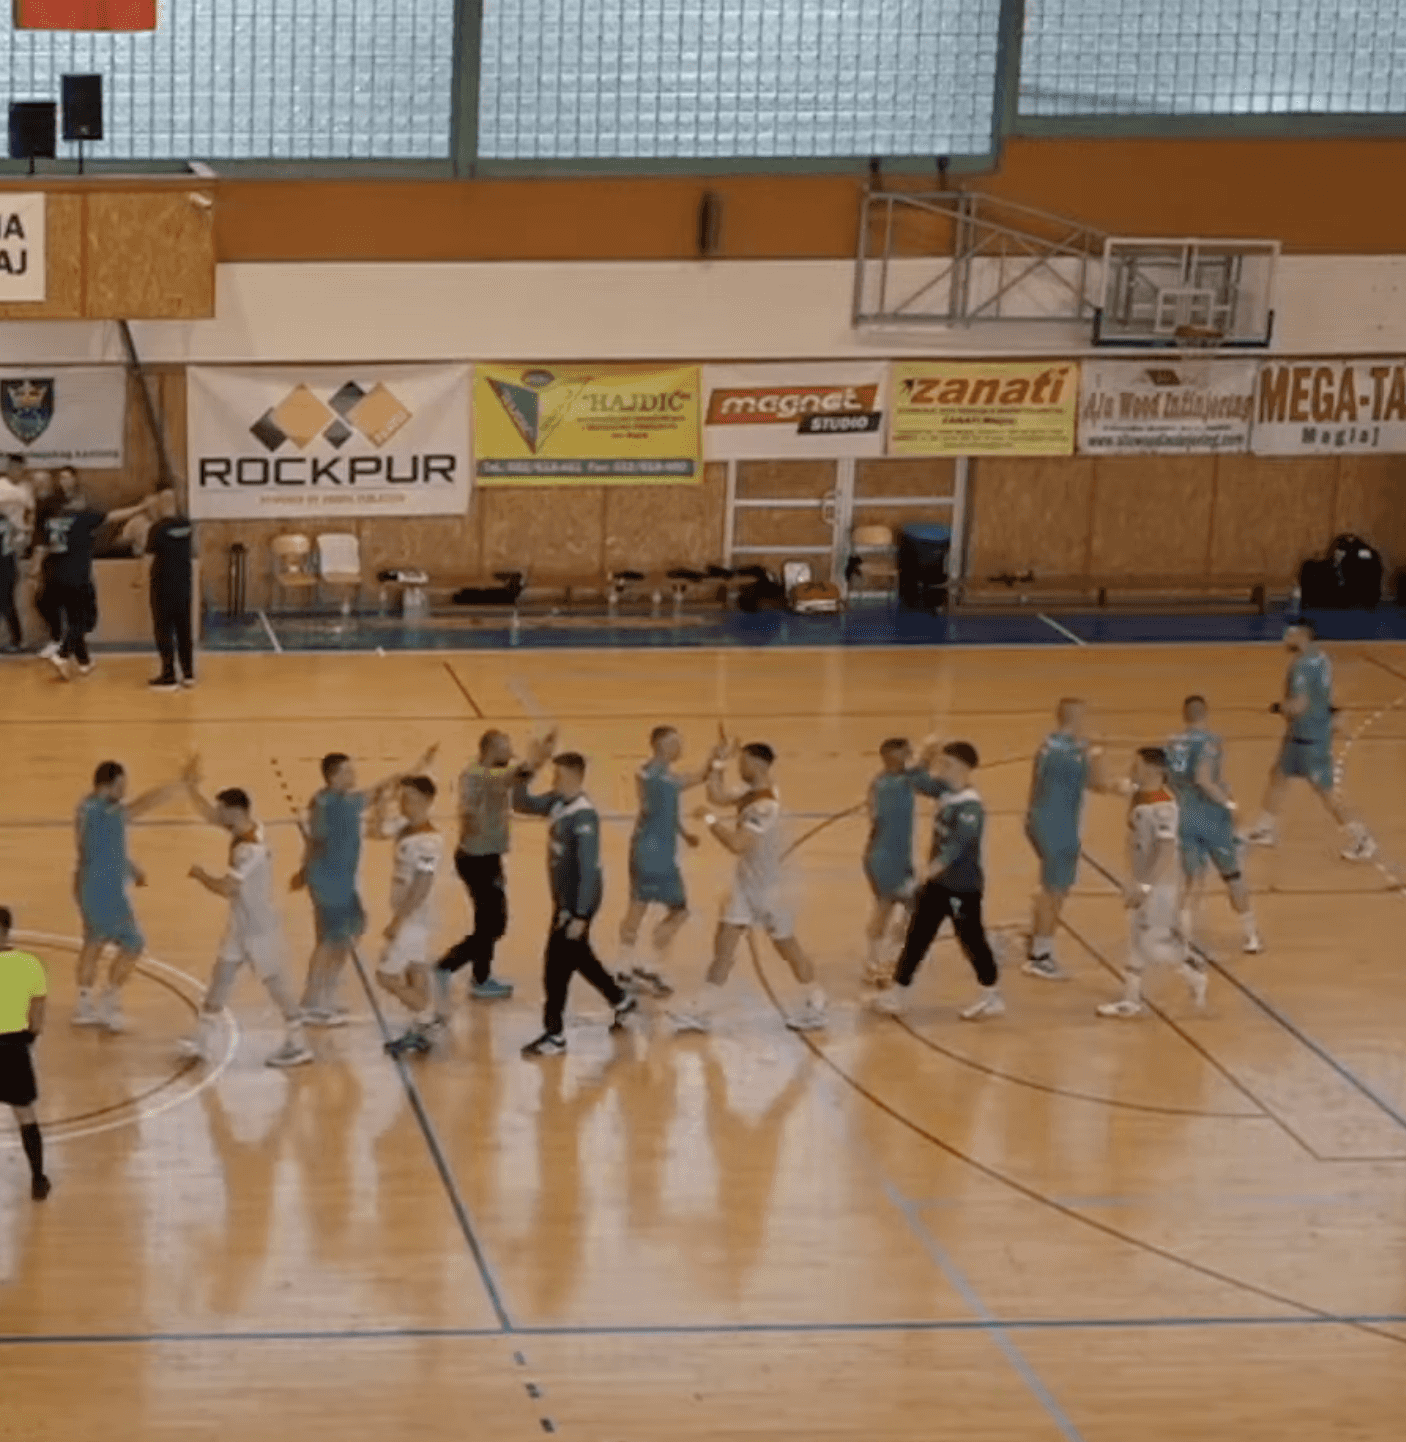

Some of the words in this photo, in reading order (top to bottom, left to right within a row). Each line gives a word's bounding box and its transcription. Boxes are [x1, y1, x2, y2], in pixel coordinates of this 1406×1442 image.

[910, 367, 1069, 404] zanati
[810, 416, 869, 431] STUDIO
[199, 454, 456, 487] ROCKPUR
